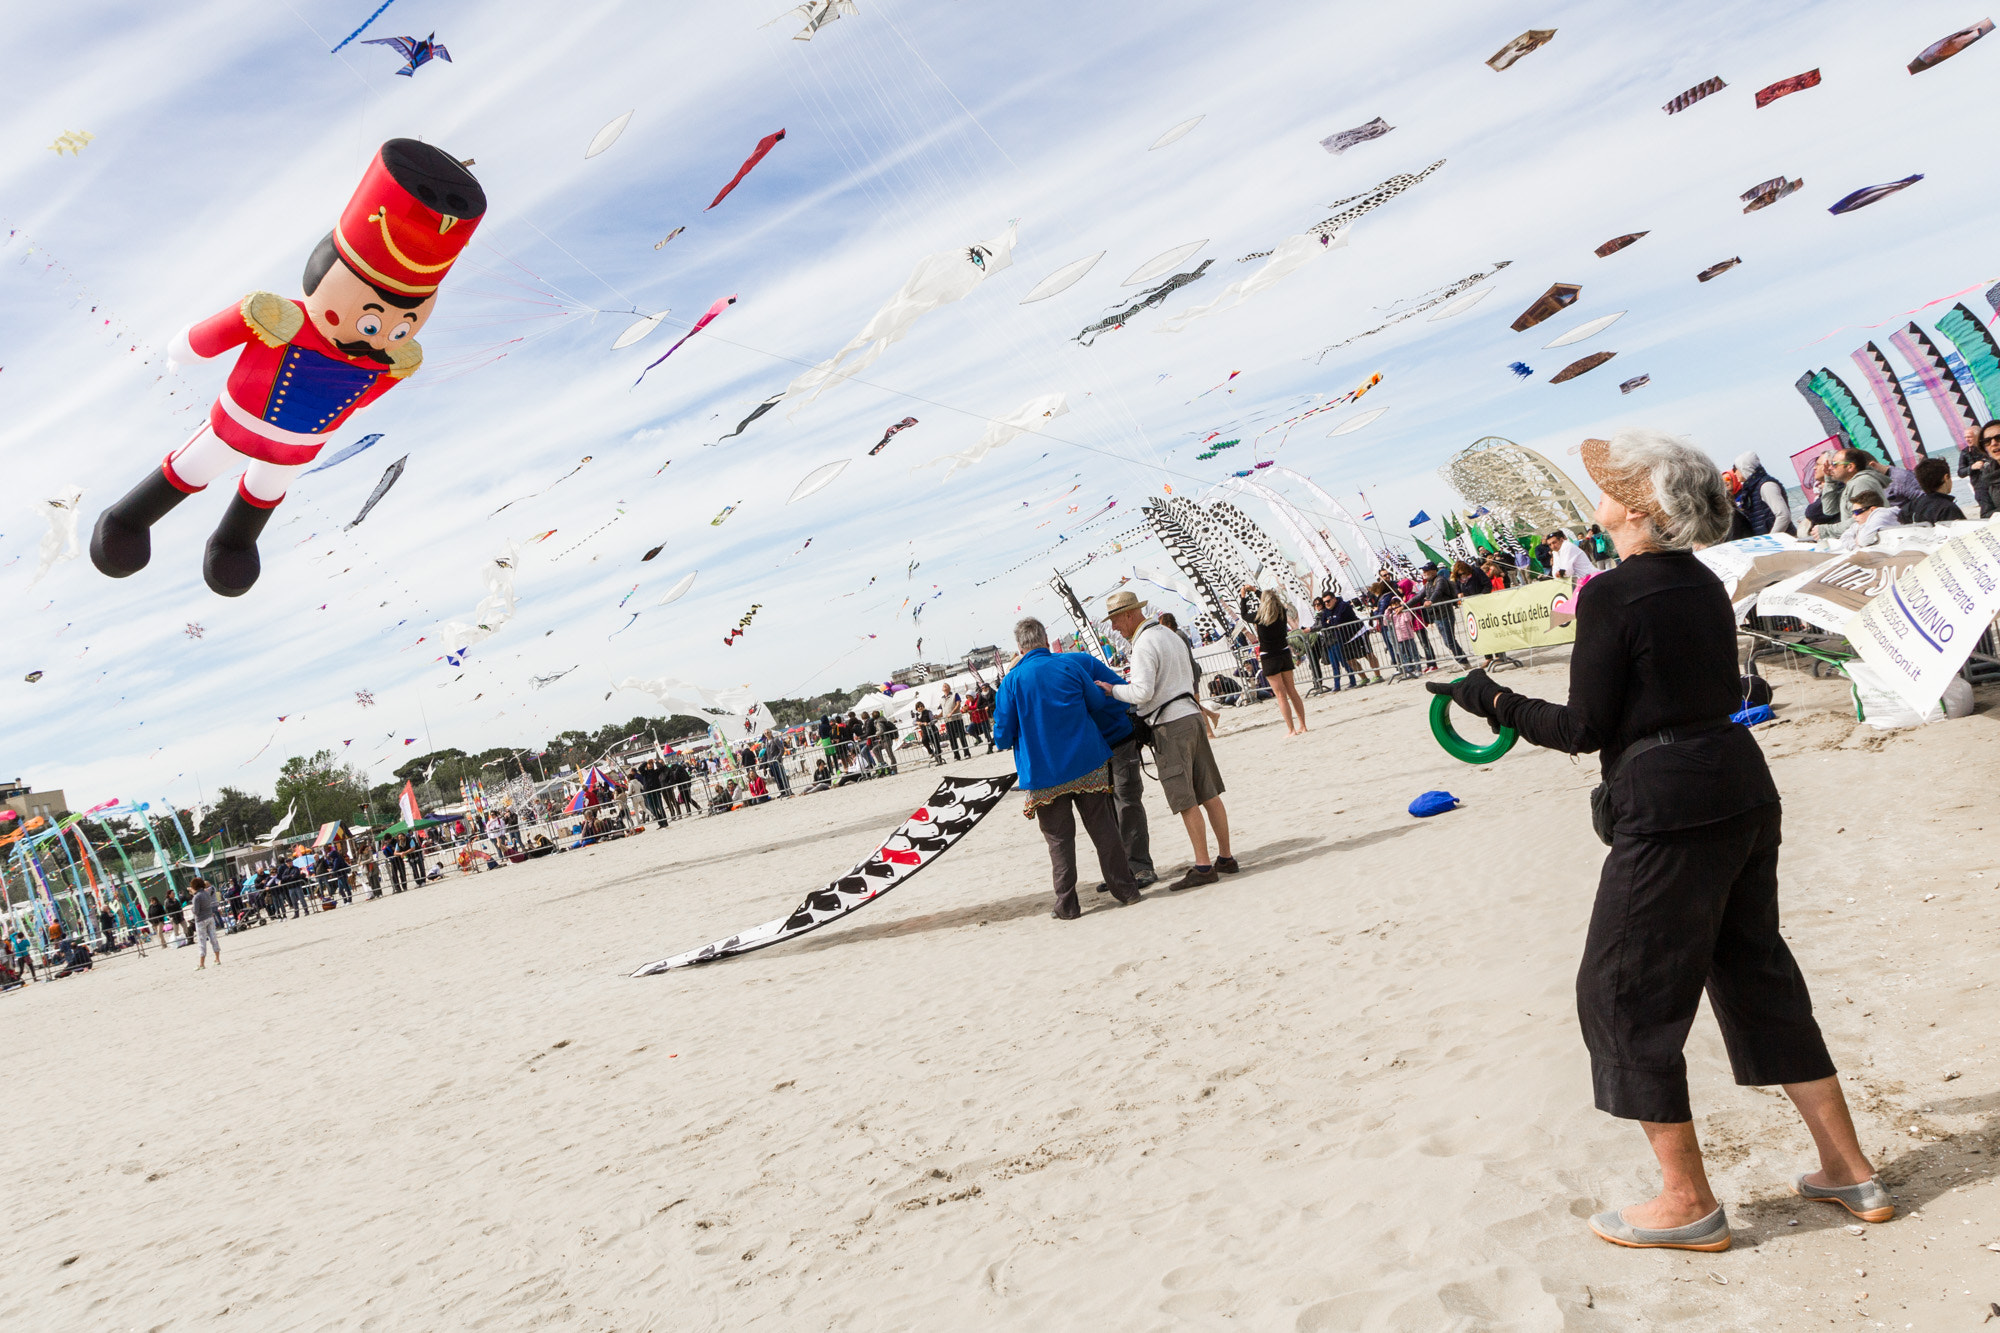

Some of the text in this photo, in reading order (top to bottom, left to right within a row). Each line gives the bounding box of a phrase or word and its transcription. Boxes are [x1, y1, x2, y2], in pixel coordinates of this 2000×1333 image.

[1820, 562, 1877, 590] VITA
[1937, 565, 1975, 615] trasparente
[1478, 613, 1500, 630] radio
[1528, 603, 1550, 621] delta
[1881, 604, 1909, 640] 5055622
[1902, 575, 1954, 643] CONDOMINIO
